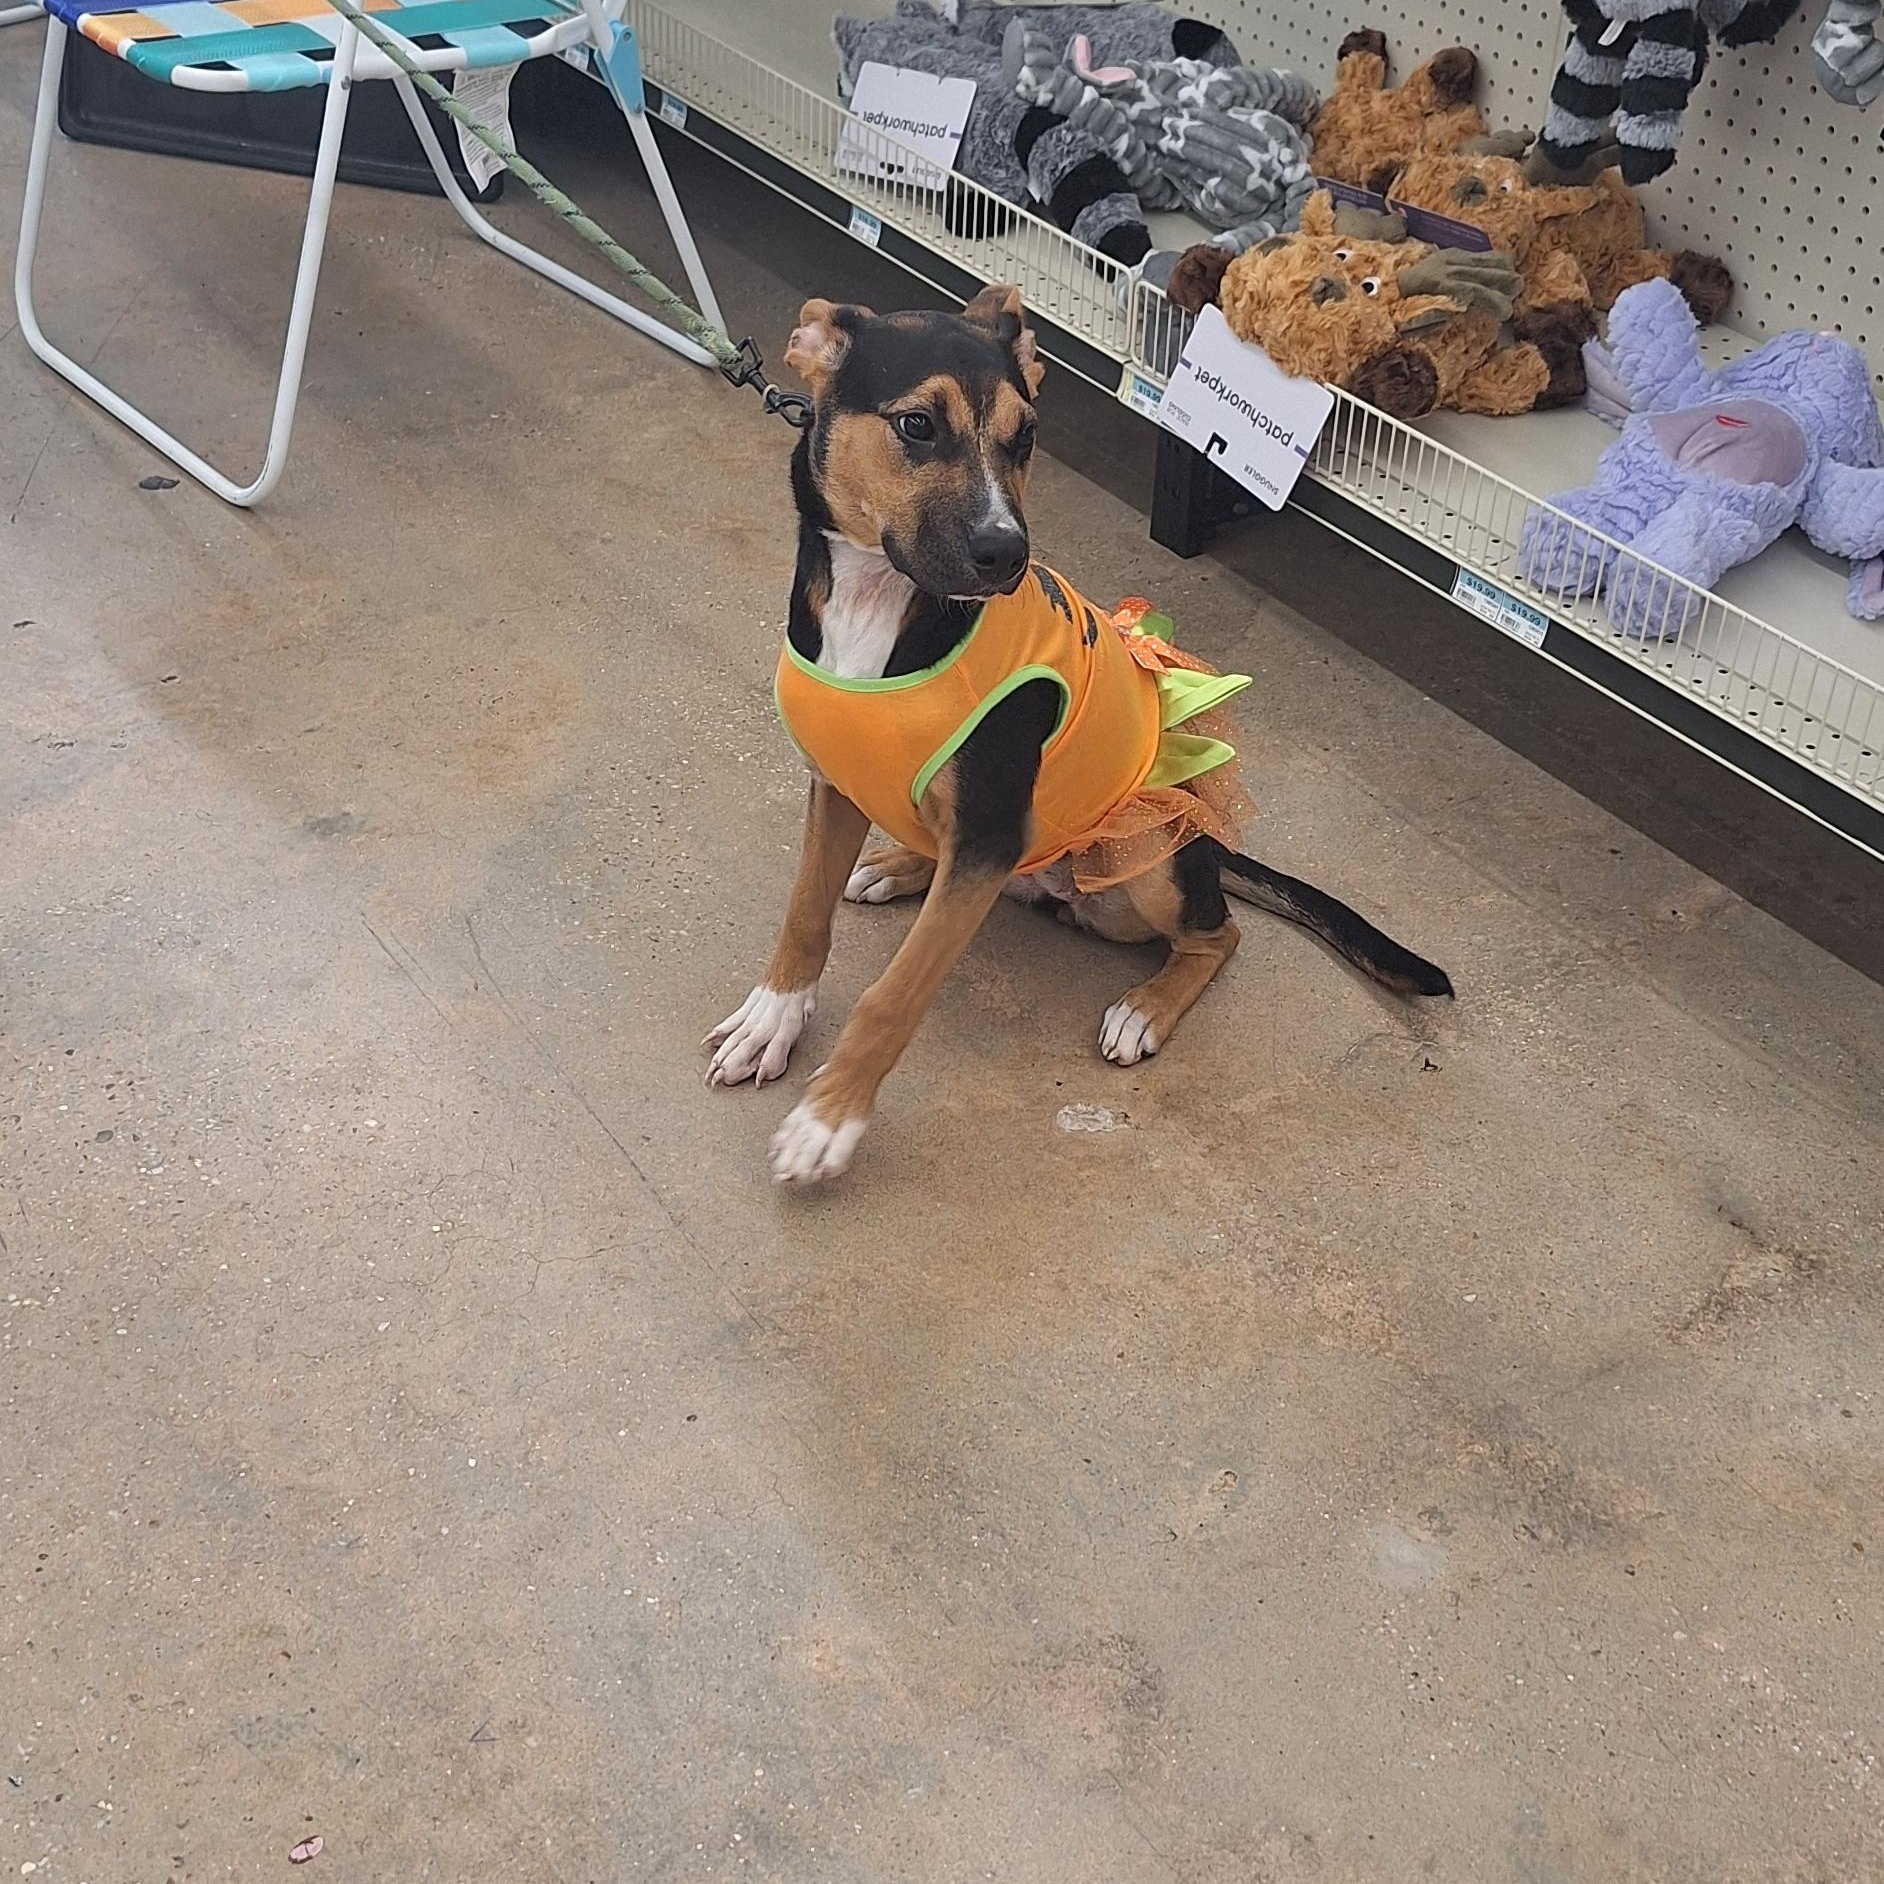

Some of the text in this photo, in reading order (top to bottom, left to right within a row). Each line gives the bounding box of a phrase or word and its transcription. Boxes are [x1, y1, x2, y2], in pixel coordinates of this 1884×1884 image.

[862, 110, 948, 139] patchworkpet
[1193, 365, 1295, 447] patchworkpet
[1243, 463, 1280, 496] SNUGGLER
[1466, 577, 1496, 600] $19.99
[1510, 603, 1541, 627] $19.99
